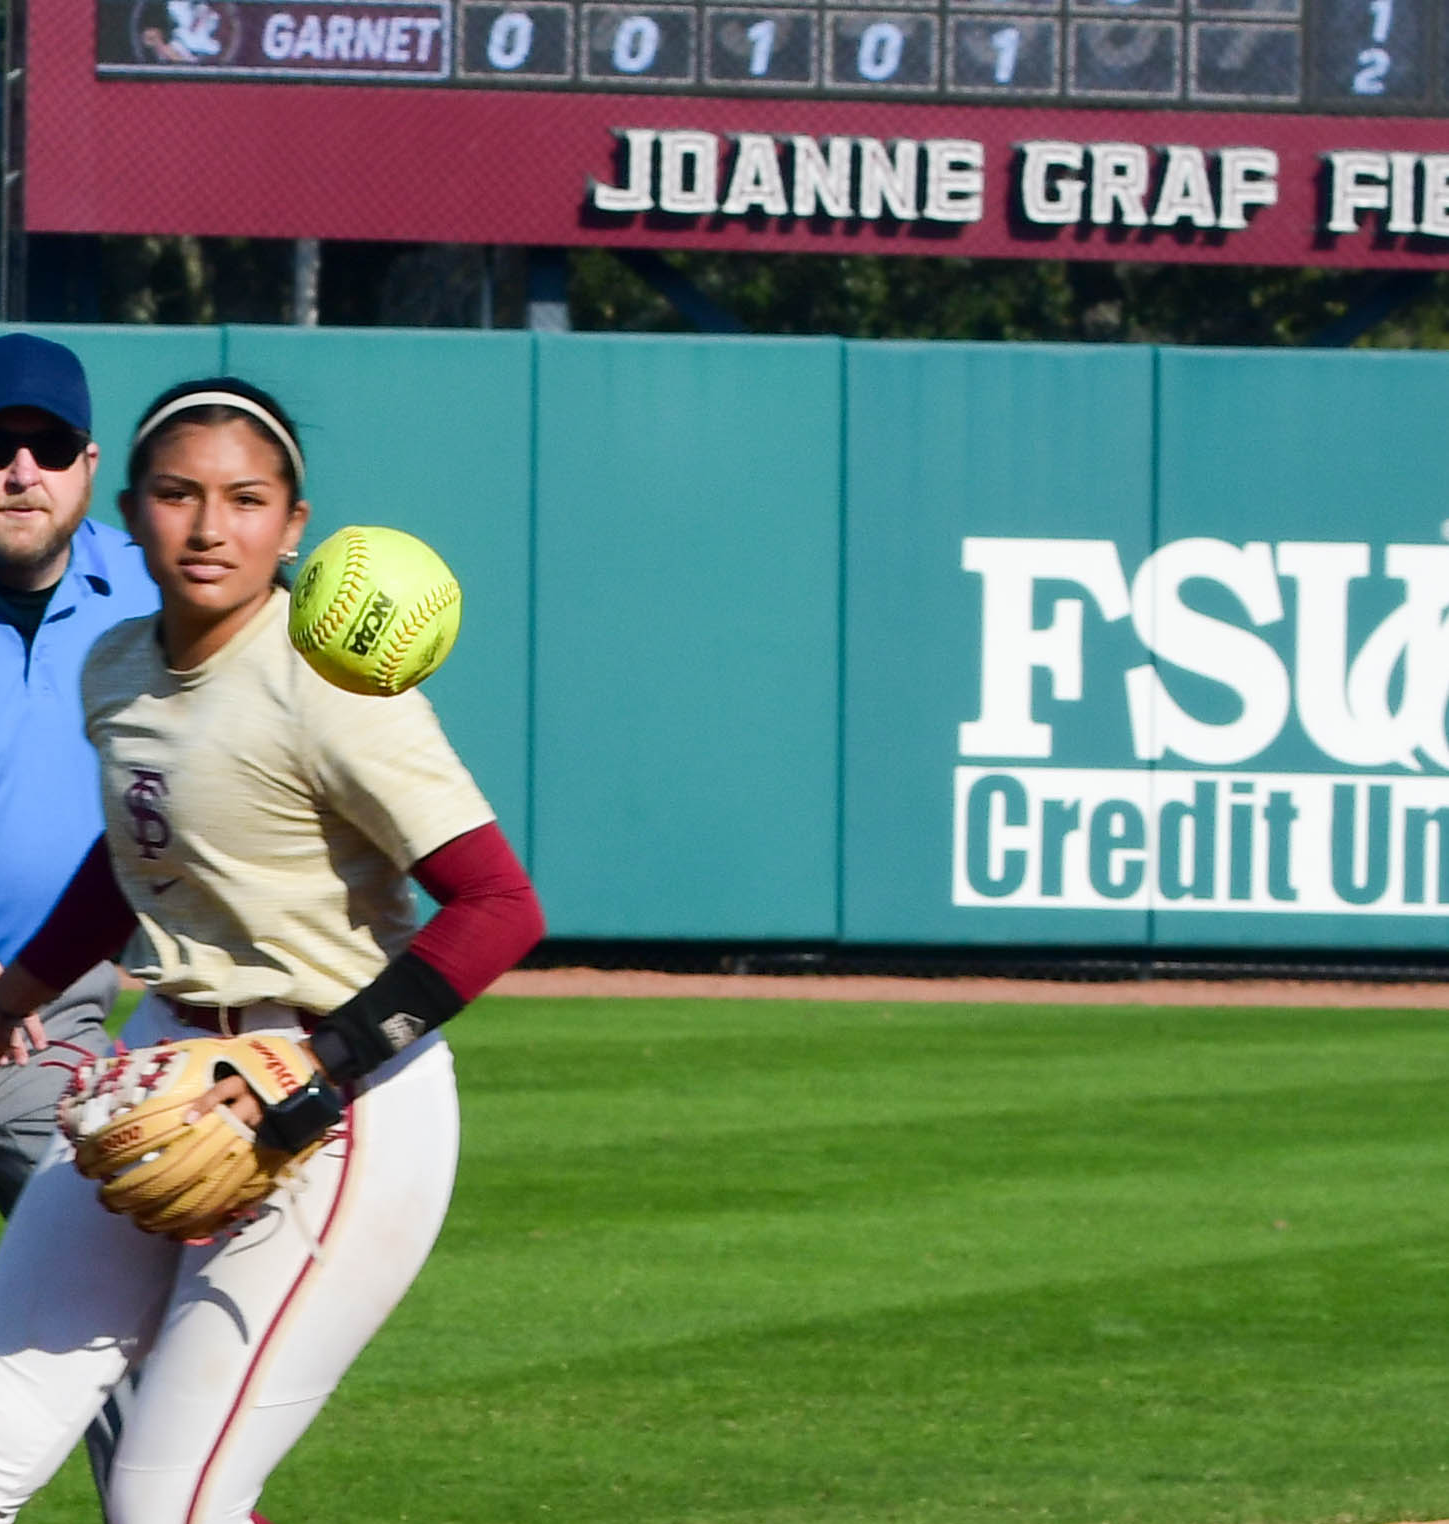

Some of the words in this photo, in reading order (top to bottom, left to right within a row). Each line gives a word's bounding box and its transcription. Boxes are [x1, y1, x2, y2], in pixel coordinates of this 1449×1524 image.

[261, 13, 441, 63] GARNET
[486, 12, 534, 70] 0
[612, 15, 660, 72] 0
[746, 19, 777, 77] 1
[856, 21, 904, 82] 0
[990, 27, 1020, 84] 1
[1353, 48, 1391, 95] 2
[594, 128, 984, 223] JOANNE
[1021, 140, 1279, 230] GRAF
[348, 590, 394, 656] NCAA
[967, 774, 1299, 902] Credit
